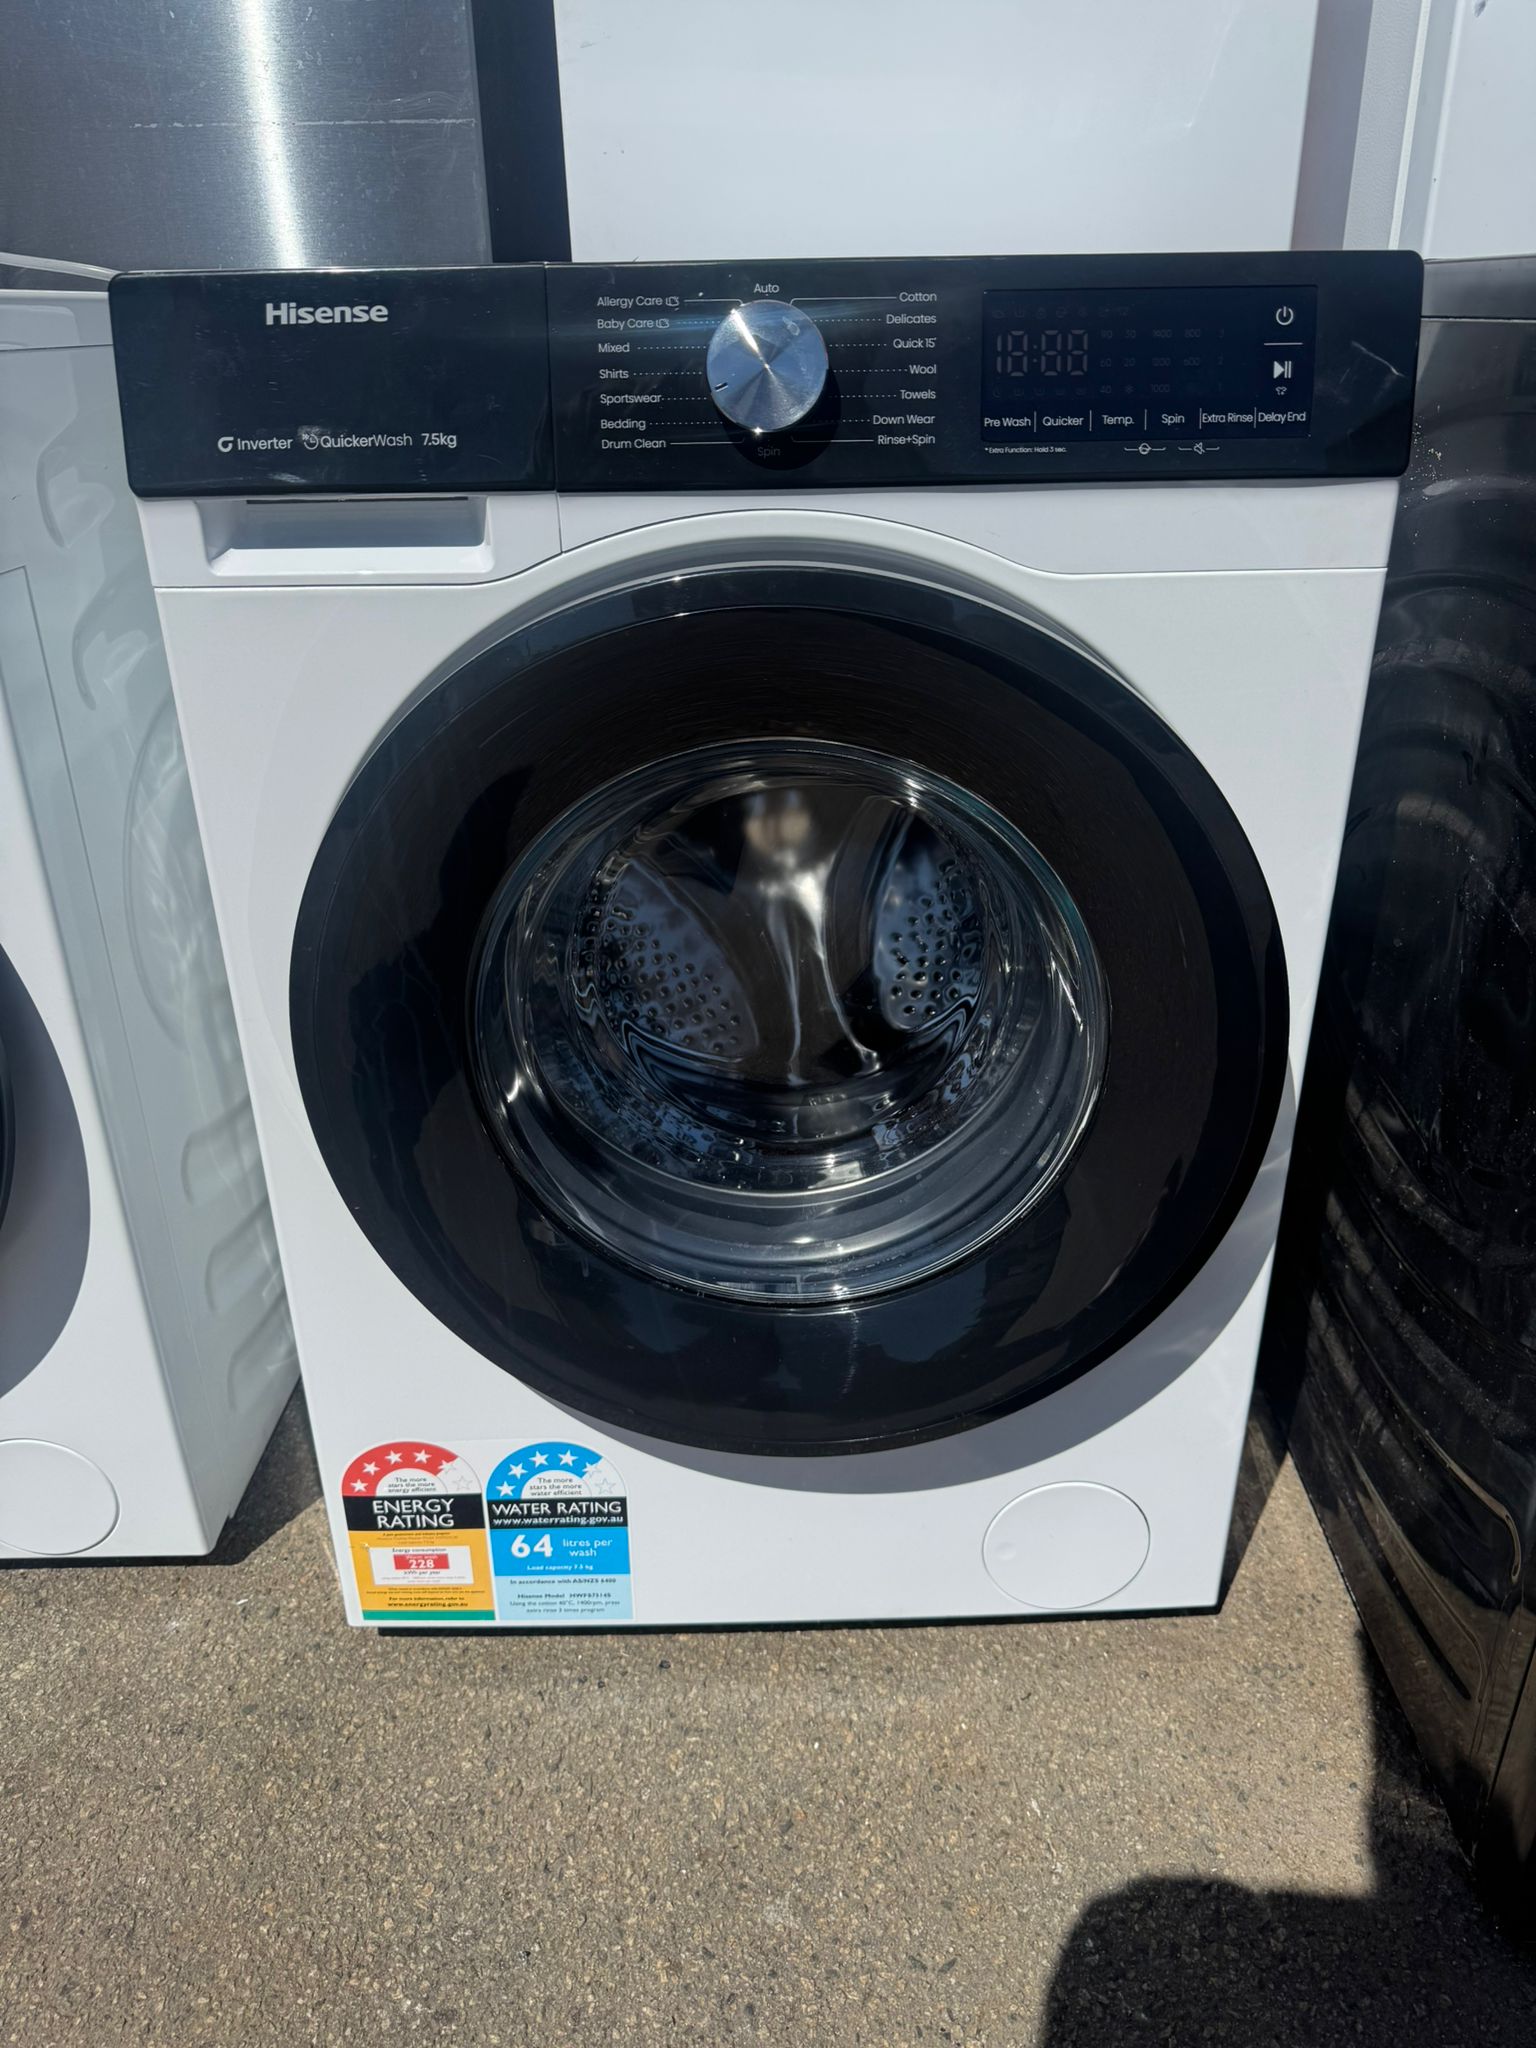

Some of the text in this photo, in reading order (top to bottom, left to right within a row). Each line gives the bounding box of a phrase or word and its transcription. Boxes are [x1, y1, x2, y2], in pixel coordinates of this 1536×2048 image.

[753, 283, 780, 293] Auto
[597, 296, 663, 308] Allergy Care
[899, 292, 937, 302] Cotton
[265, 303, 389, 326] Hisense
[886, 314, 937, 324] Delicates
[597, 318, 654, 330] Baby Care
[598, 343, 630, 353] Mixed
[893, 339, 923, 349] Quick
[599, 369, 629, 379] Shirts
[909, 365, 937, 375] Wool
[600, 393, 661, 404] Sportswear
[900, 390, 936, 400] Towels
[873, 414, 935, 425] Down Wear
[984, 417, 1031, 427] Pre Wash
[1042, 416, 1084, 427] Quicker
[1102, 415, 1135, 428] Temp.
[1161, 413, 1185, 426] Spin
[1202, 413, 1253, 423] Extra Rinse
[1258, 411, 1306, 424] Delay End
[600, 418, 646, 430] Bedding
[237, 432, 457, 451] Inverter QuickerWash 7.5kg
[602, 438, 666, 449] Drum Clean
[877, 434, 935, 446] Rinse+Spin
[757, 446, 781, 457] Spin
[372, 1498, 454, 1514] ENERGY
[492, 1502, 622, 1515] WATER RATING
[377, 1514, 454, 1528] RATING
[493, 1516, 623, 1525] www.waterrating.gov.au
[511, 1534, 553, 1558] 64
[563, 1538, 612, 1548] litres per
[570, 1548, 596, 1557] wash
[409, 1560, 435, 1569] 228
